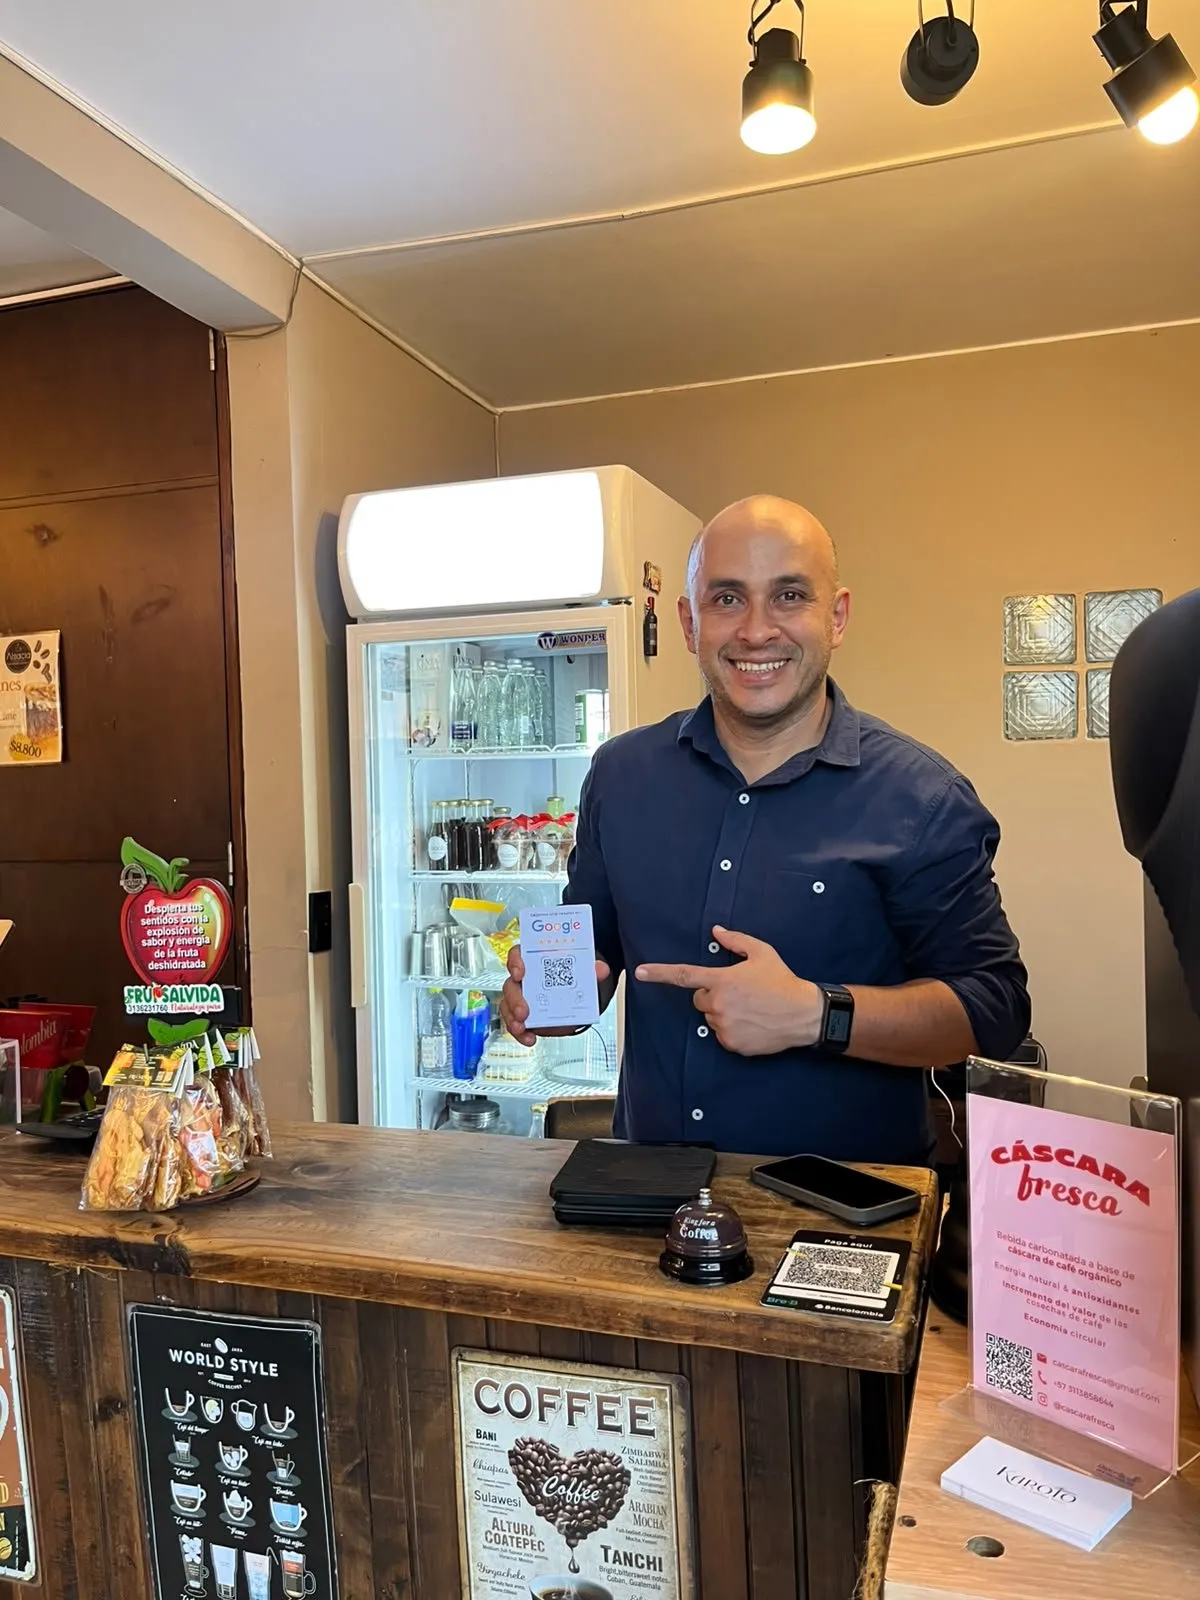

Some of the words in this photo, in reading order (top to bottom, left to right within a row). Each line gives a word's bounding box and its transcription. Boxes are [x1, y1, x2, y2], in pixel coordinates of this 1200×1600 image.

[560, 632, 606, 644] WONDER
[145, 903, 190, 916] Despierta
[190, 904, 205, 913] tus
[141, 916, 180, 926] sentidos
[181, 915, 199, 924] con
[200, 914, 210, 923] la
[531, 919, 582, 934] Google
[192, 925, 205, 935] de
[141, 937, 167, 947] sabor
[168, 939, 175, 949] y
[154, 949, 166, 958] de
[167, 948, 176, 958] la
[177, 948, 200, 958] fruta
[148, 959, 207, 971] deshidratada
[20, 1019, 58, 1056] olombia
[990, 1139, 1151, 1208] CÁSCARA
[1017, 1163, 1123, 1217] fresca
[679, 1223, 720, 1241] Coffee
[823, 1238, 849, 1248] Paga
[996, 1230, 1027, 1248] Bebida
[1028, 1242, 1087, 1267] carbonatada
[1088, 1260, 1095, 1269] a
[1096, 1260, 1120, 1279] base
[1121, 1268, 1136, 1284] de
[1007, 1245, 1041, 1264] cáscara
[1042, 1256, 1055, 1268] de
[1056, 1260, 1077, 1275] café
[1077, 1267, 1122, 1289] orgánico
[1028, 1273, 1061, 1292] natural
[1071, 1288, 1140, 1316] antioxidantes
[825, 1304, 885, 1319] Bancolombia
[1002, 1280, 1053, 1305] Incremento
[1055, 1299, 1070, 1310] del
[1071, 1305, 1097, 1320] valor
[1099, 1311, 1111, 1324] de
[1113, 1316, 1128, 1330] las
[1025, 1298, 1066, 1319] cosechas
[1068, 1311, 1081, 1323] de
[1083, 1315, 1104, 1331] café
[1024, 1312, 1068, 1335] Economía
[1070, 1330, 1107, 1349] circular
[168, 1348, 226, 1369] WORLD
[229, 1357, 279, 1378] STYLE
[474, 1377, 658, 1440] COFFEE
[1053, 1400, 1116, 1431] @cascarafresca
[475, 1428, 498, 1442] BANI
[620, 1446, 668, 1461] ZIMBABWE
[472, 1457, 509, 1476] Chiapas
[474, 1489, 521, 1508] Sulawesi
[541, 1473, 601, 1505] Coffee
[629, 1499, 668, 1517] ARABIAN
[492, 1516, 537, 1537] ALTURA
[633, 1513, 664, 1531] MOCHA
[484, 1529, 545, 1553] COATEPEC
[600, 1544, 663, 1573] TANCHI
